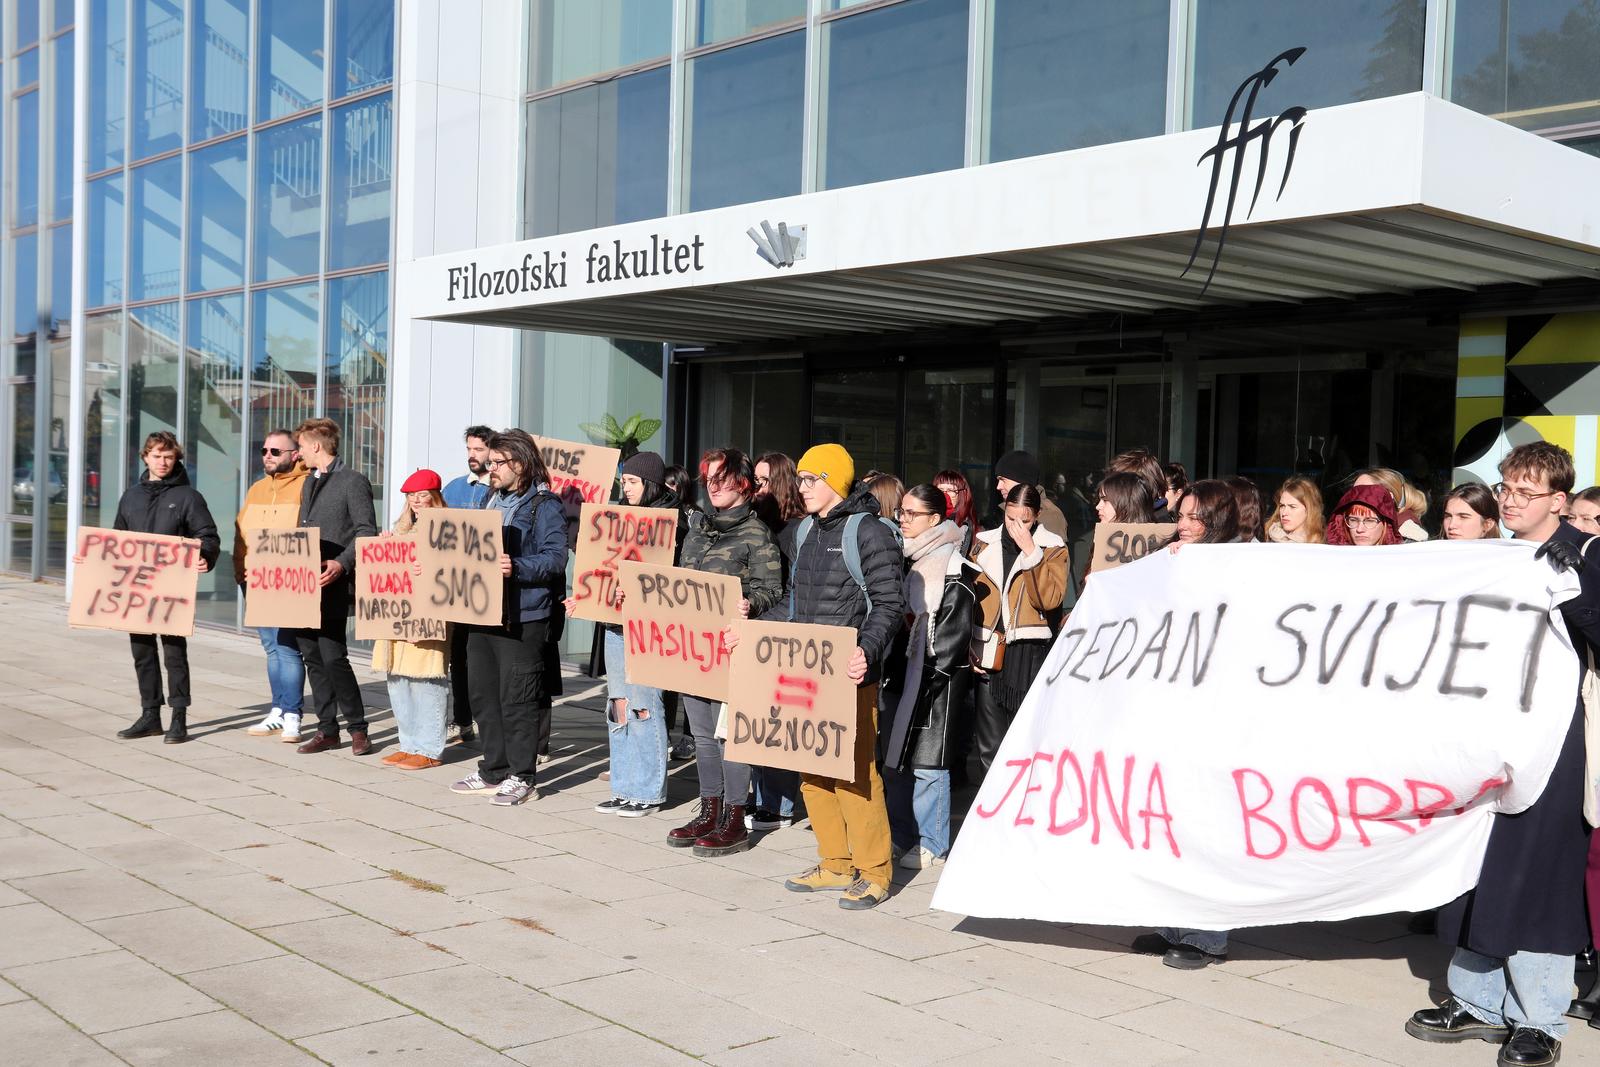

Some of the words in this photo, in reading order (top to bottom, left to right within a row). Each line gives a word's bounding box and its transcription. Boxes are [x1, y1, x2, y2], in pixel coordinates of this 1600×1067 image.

[447, 250, 567, 301] Filozofski
[586, 234, 704, 283] fakultet
[462, 521, 497, 562] VAS
[591, 511, 675, 548] STUDENTI
[80, 533, 201, 568] PROTEST
[111, 565, 160, 589] JE
[251, 566, 316, 594] SLOBODNO
[369, 570, 413, 595] VLADA
[431, 564, 489, 616] SMO
[575, 569, 622, 611] STU
[638, 573, 725, 616] PROTIV
[87, 588, 189, 622] ISPIT
[358, 597, 412, 620] NAROD
[628, 619, 730, 673] NASILJA
[755, 636, 834, 676] OTPOR
[1046, 602, 1228, 687] JEDAN
[1257, 594, 1549, 713] SVIJET
[733, 705, 847, 758] DUŽNOST
[976, 749, 1181, 858] JEDNA
